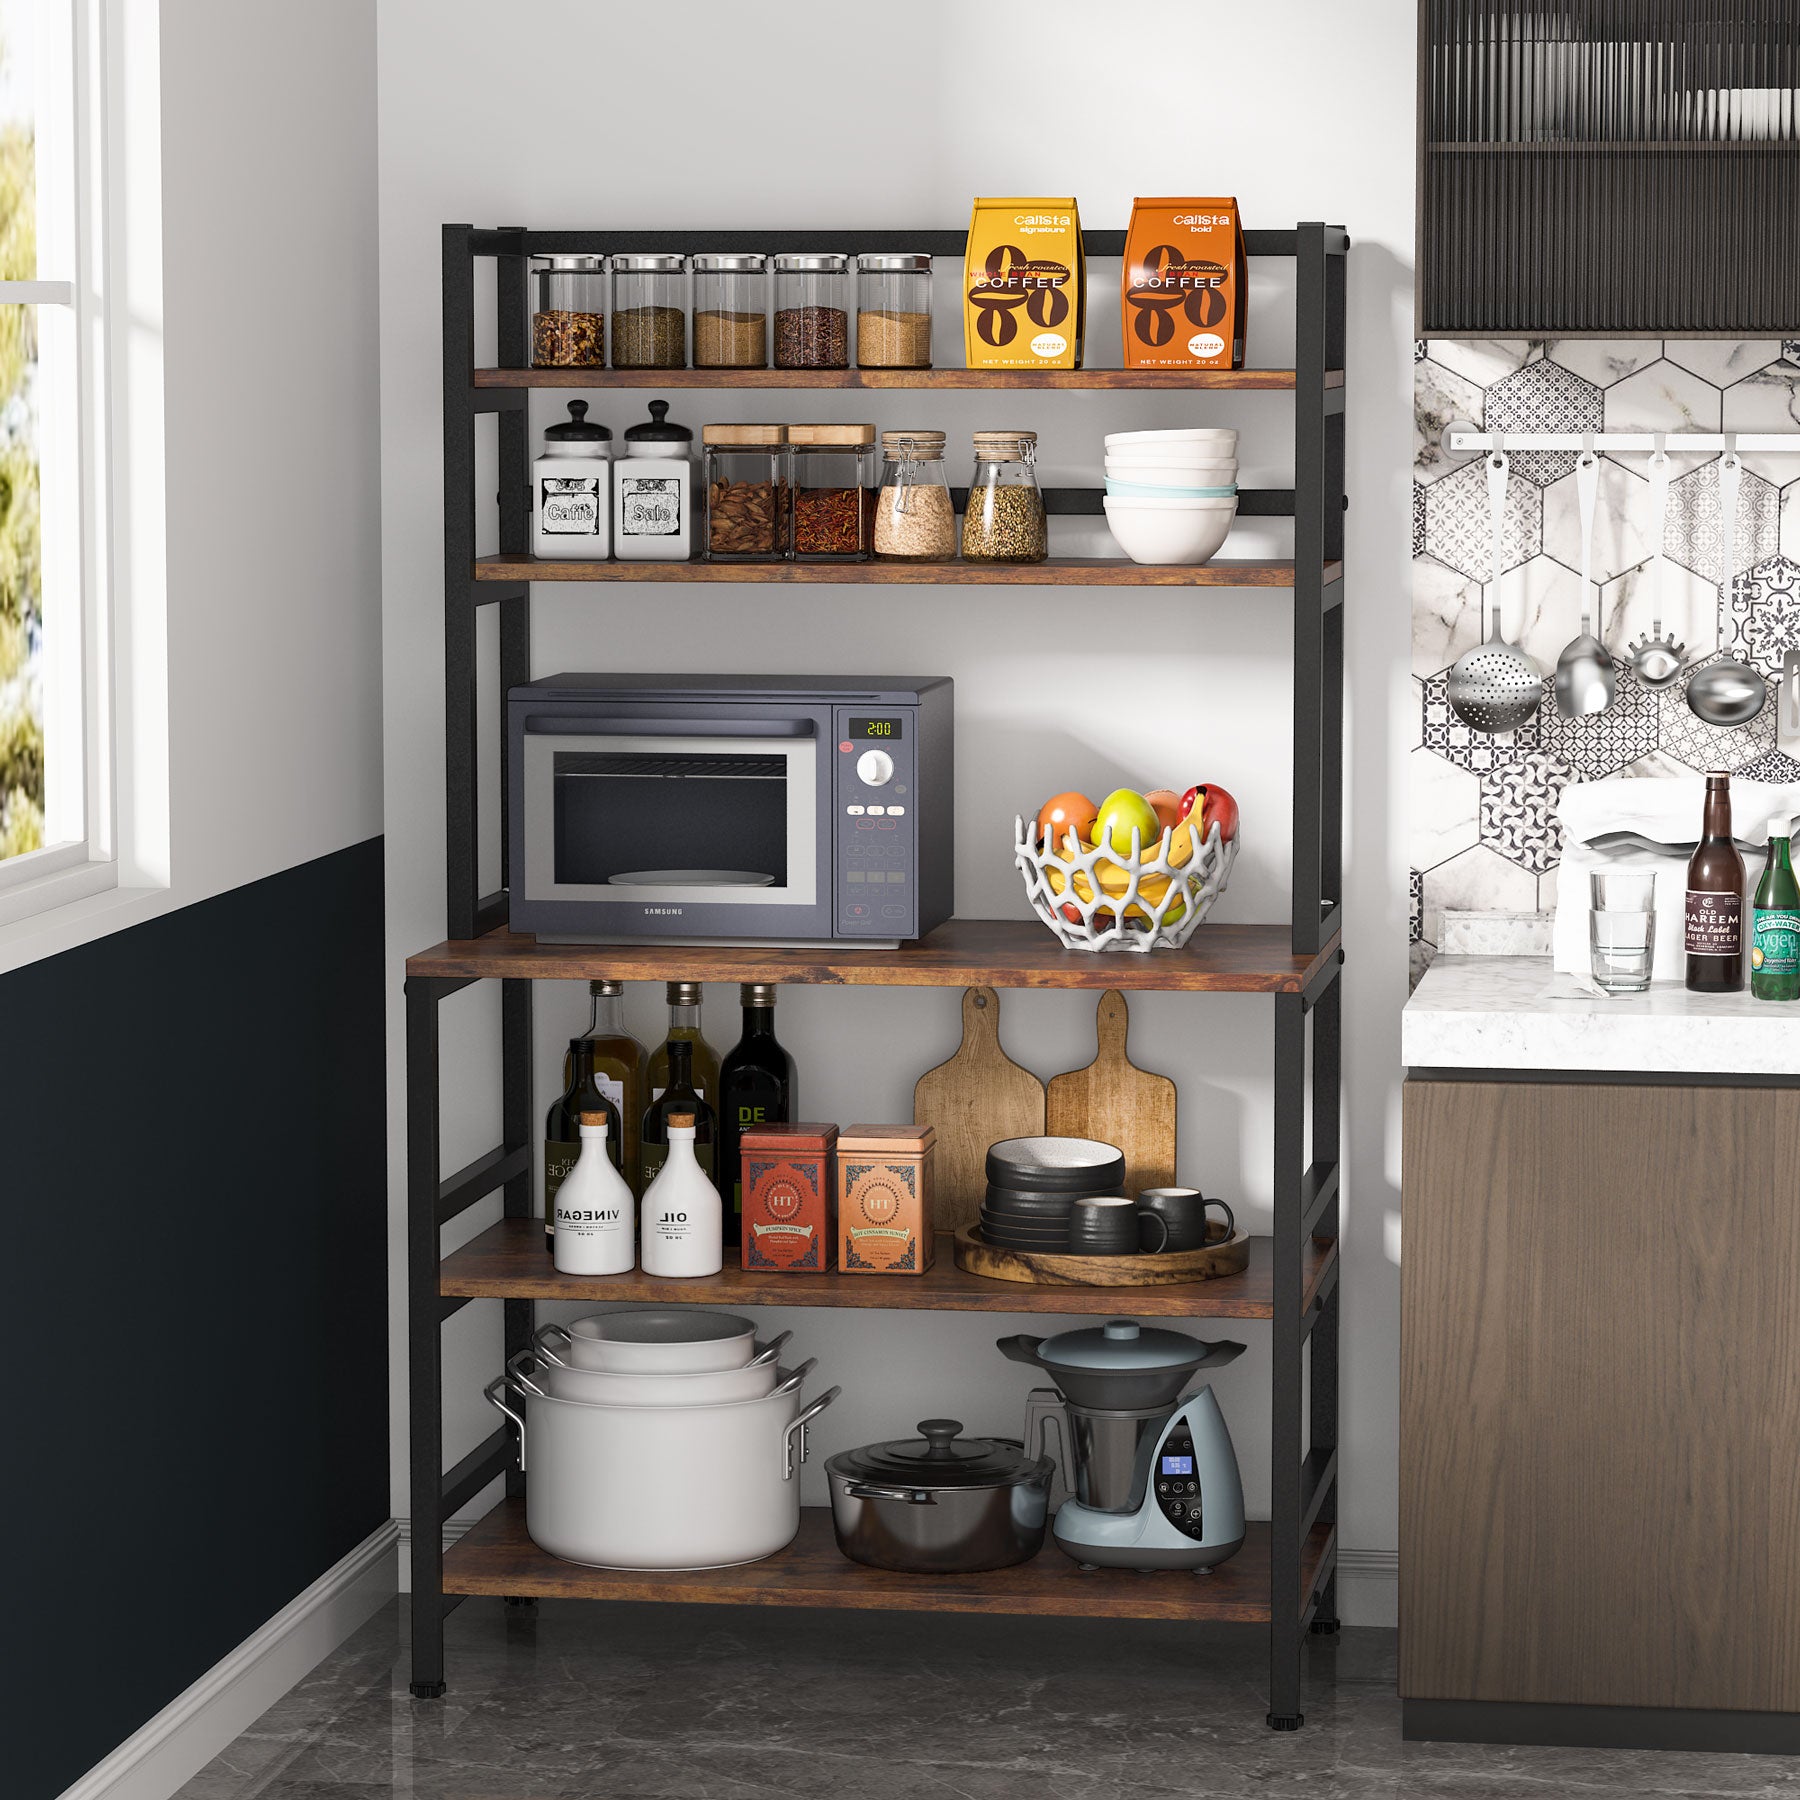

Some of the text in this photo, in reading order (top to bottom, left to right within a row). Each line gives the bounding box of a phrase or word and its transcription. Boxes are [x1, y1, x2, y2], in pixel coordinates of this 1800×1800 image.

[1019, 226, 1066, 235] signature
[1155, 263, 1230, 273] fresh roasted
[975, 277, 1064, 288] COFFEE
[1133, 277, 1221, 288] COFFEE
[633, 505, 671, 521] Sale
[867, 722, 891, 735] 2:00
[1685, 912, 1739, 924] HAREEM
[1707, 925, 1730, 934] Label
[1685, 933, 1738, 942] AGER BEER
[738, 1107, 766, 1122] DE
[773, 1196, 794, 1207] HT
[870, 1199, 891, 1210] HT
